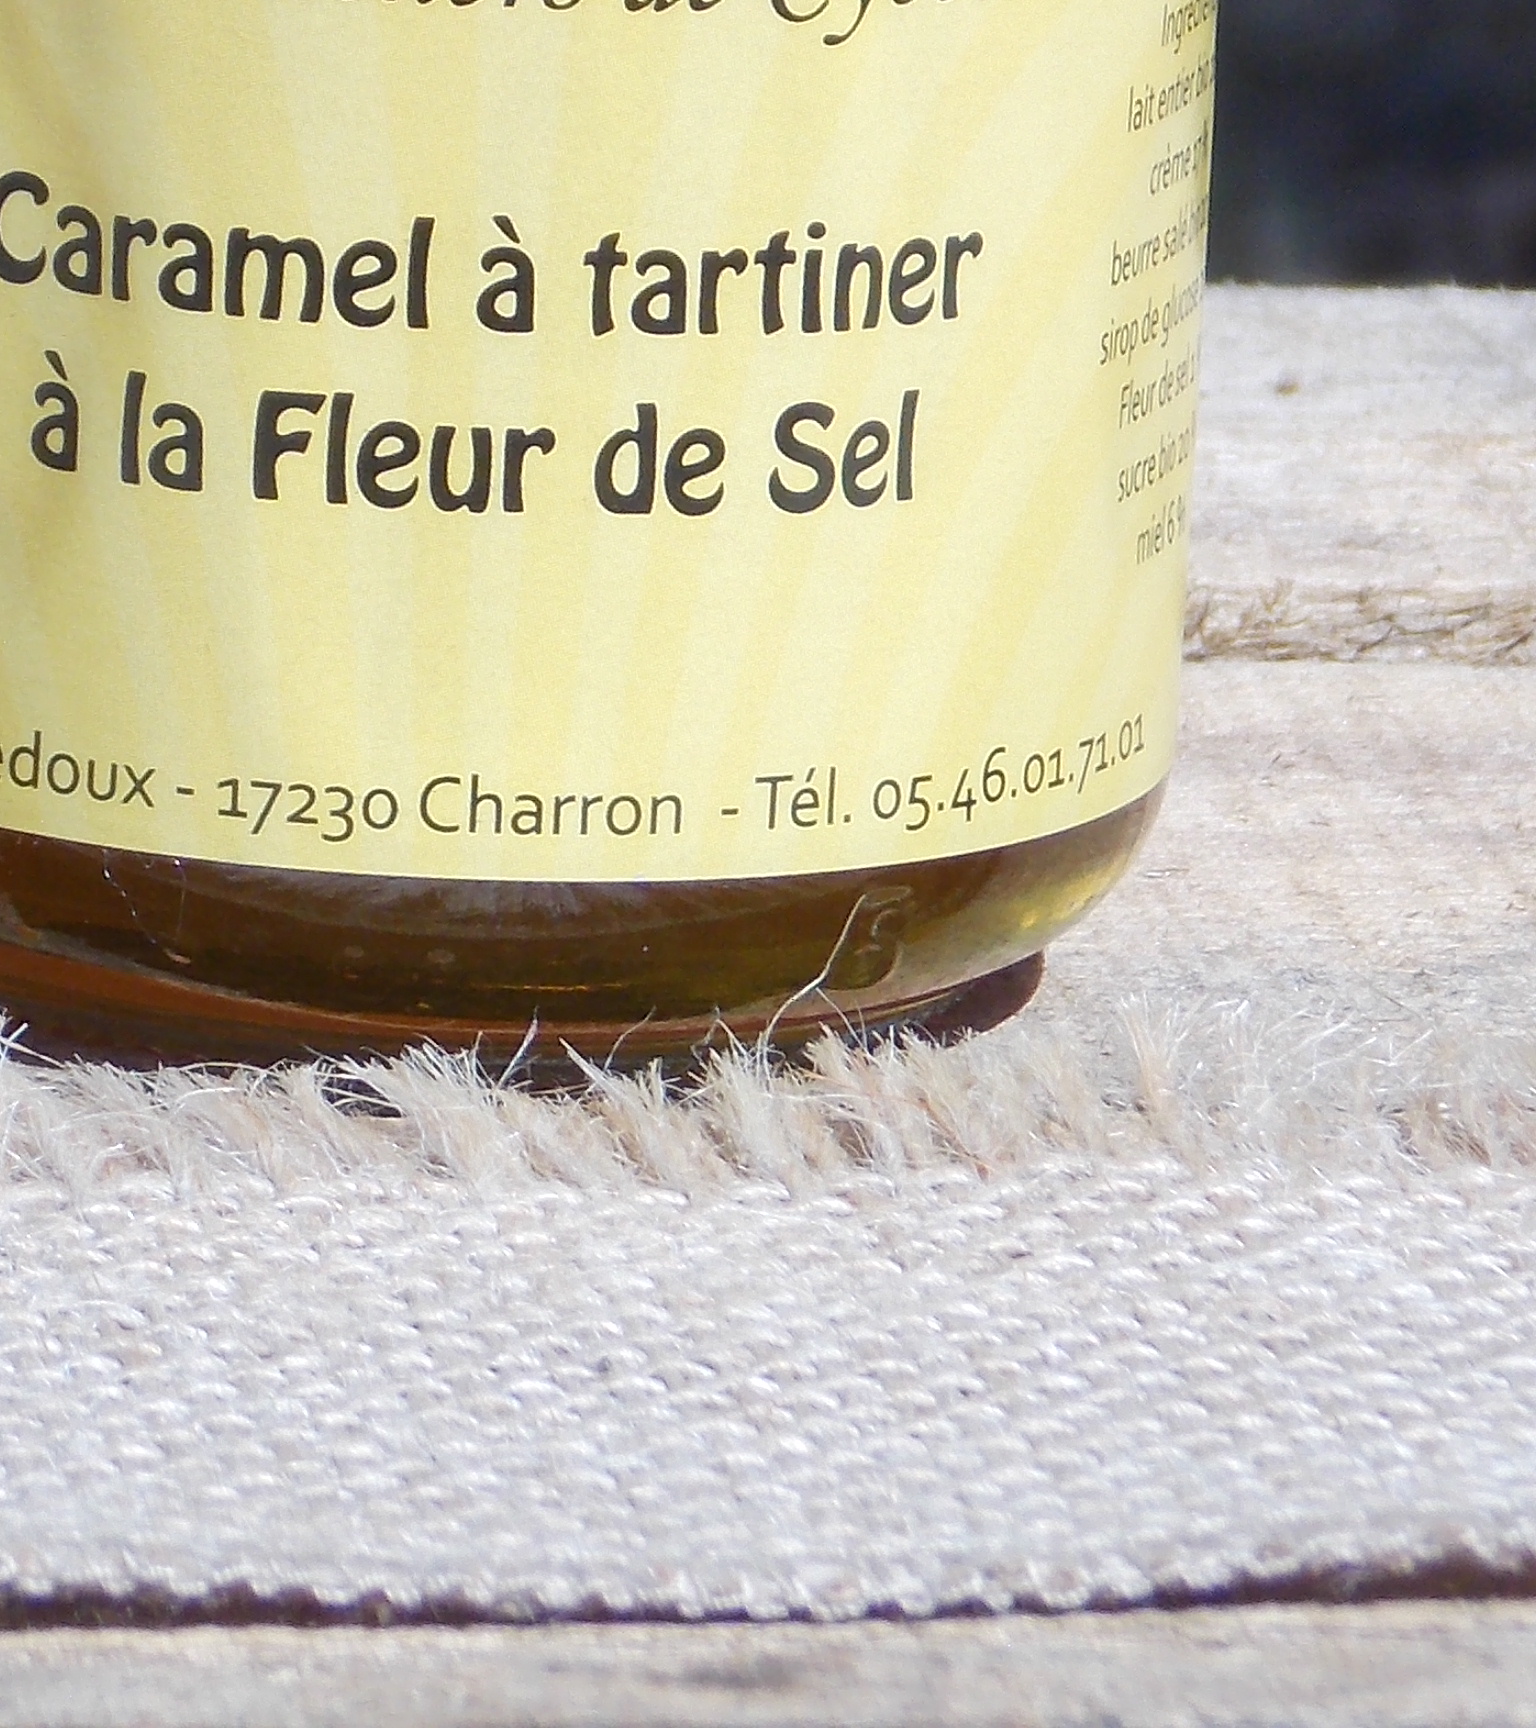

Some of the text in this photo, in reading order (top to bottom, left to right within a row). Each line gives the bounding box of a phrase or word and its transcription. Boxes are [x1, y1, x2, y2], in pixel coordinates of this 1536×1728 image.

[1127, 84, 1154, 132] lait
[1149, 143, 1190, 196] crème
[474, 213, 536, 335] à
[581, 220, 985, 338] tartiner
[1111, 233, 1160, 287] beurre
[1100, 318, 1139, 366] sirop
[1141, 297, 1159, 345] de
[1119, 378, 1156, 429] Fleur
[1158, 359, 1175, 409] de
[29, 348, 921, 518] à la Fleur de Sel
[1117, 453, 1156, 504] sucre
[1136, 504, 1166, 565] miel
[216, 775, 400, 844] 17230
[418, 772, 683, 837] Charron
[753, 765, 853, 831] Tél.
[871, 712, 1147, 832] 05.46.01.71.01
